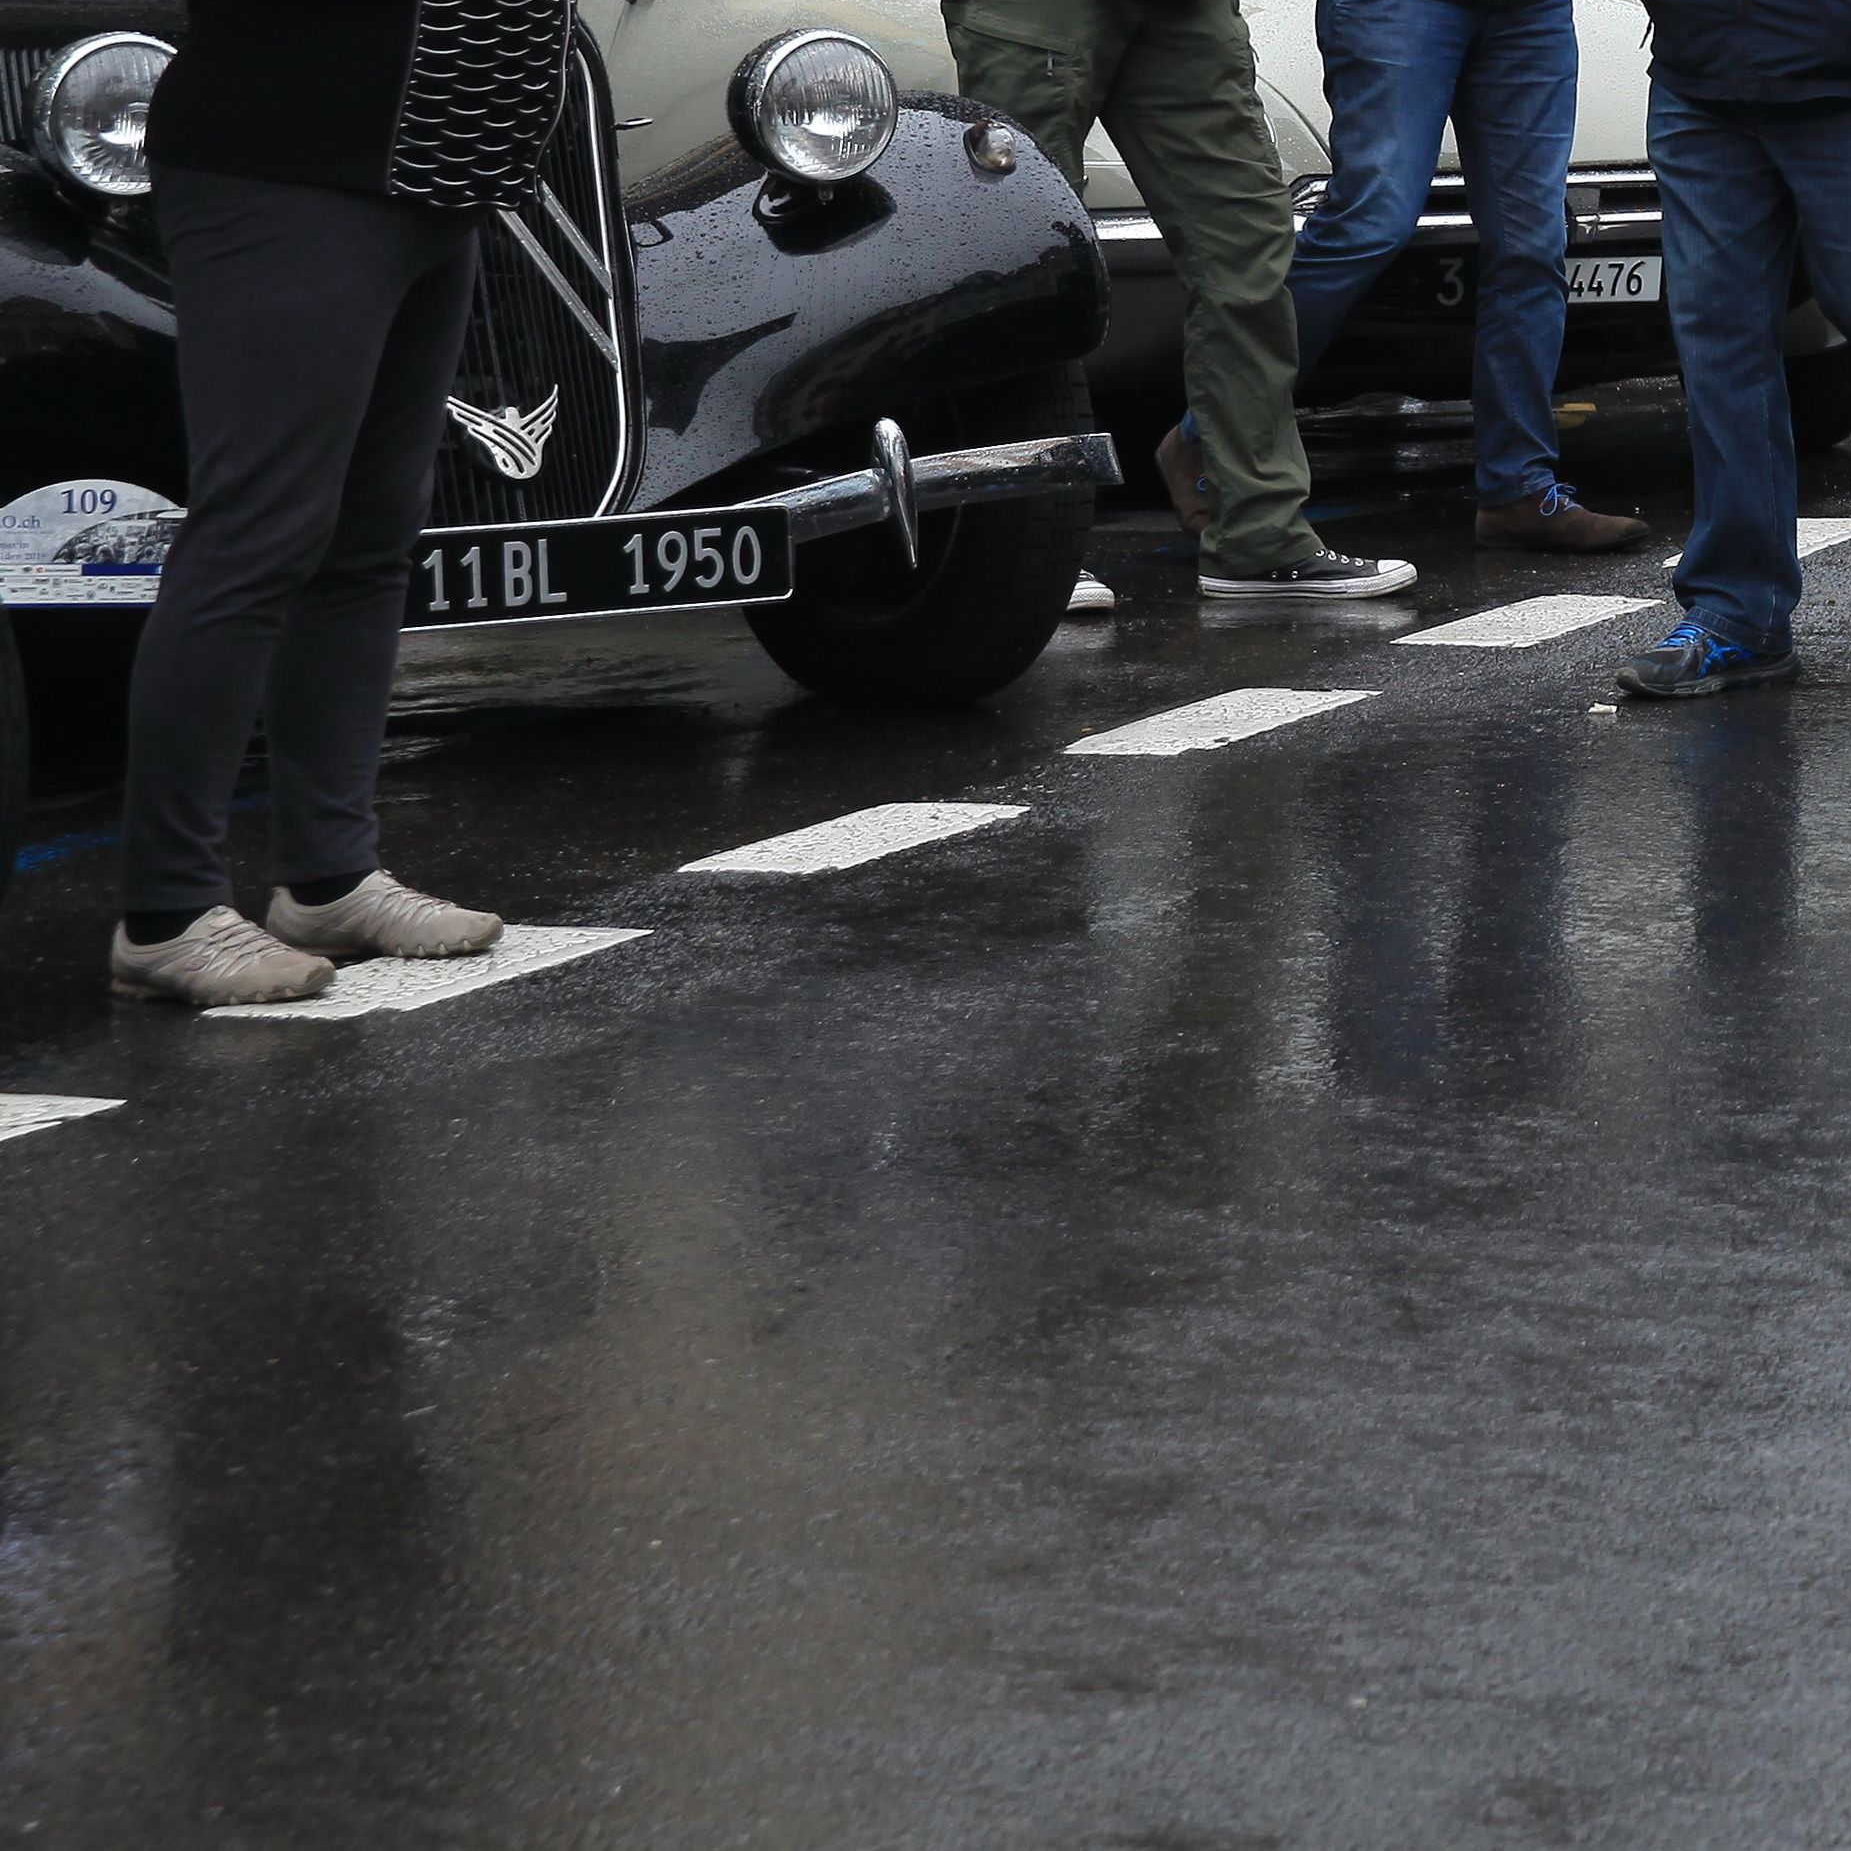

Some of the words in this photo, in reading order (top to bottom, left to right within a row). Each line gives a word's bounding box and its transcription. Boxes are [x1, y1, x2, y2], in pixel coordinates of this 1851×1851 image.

[1436, 257, 1465, 306] 3
[61, 488, 118, 515] 109
[0, 515, 41, 529] O.ch
[622, 525, 764, 596] 1950
